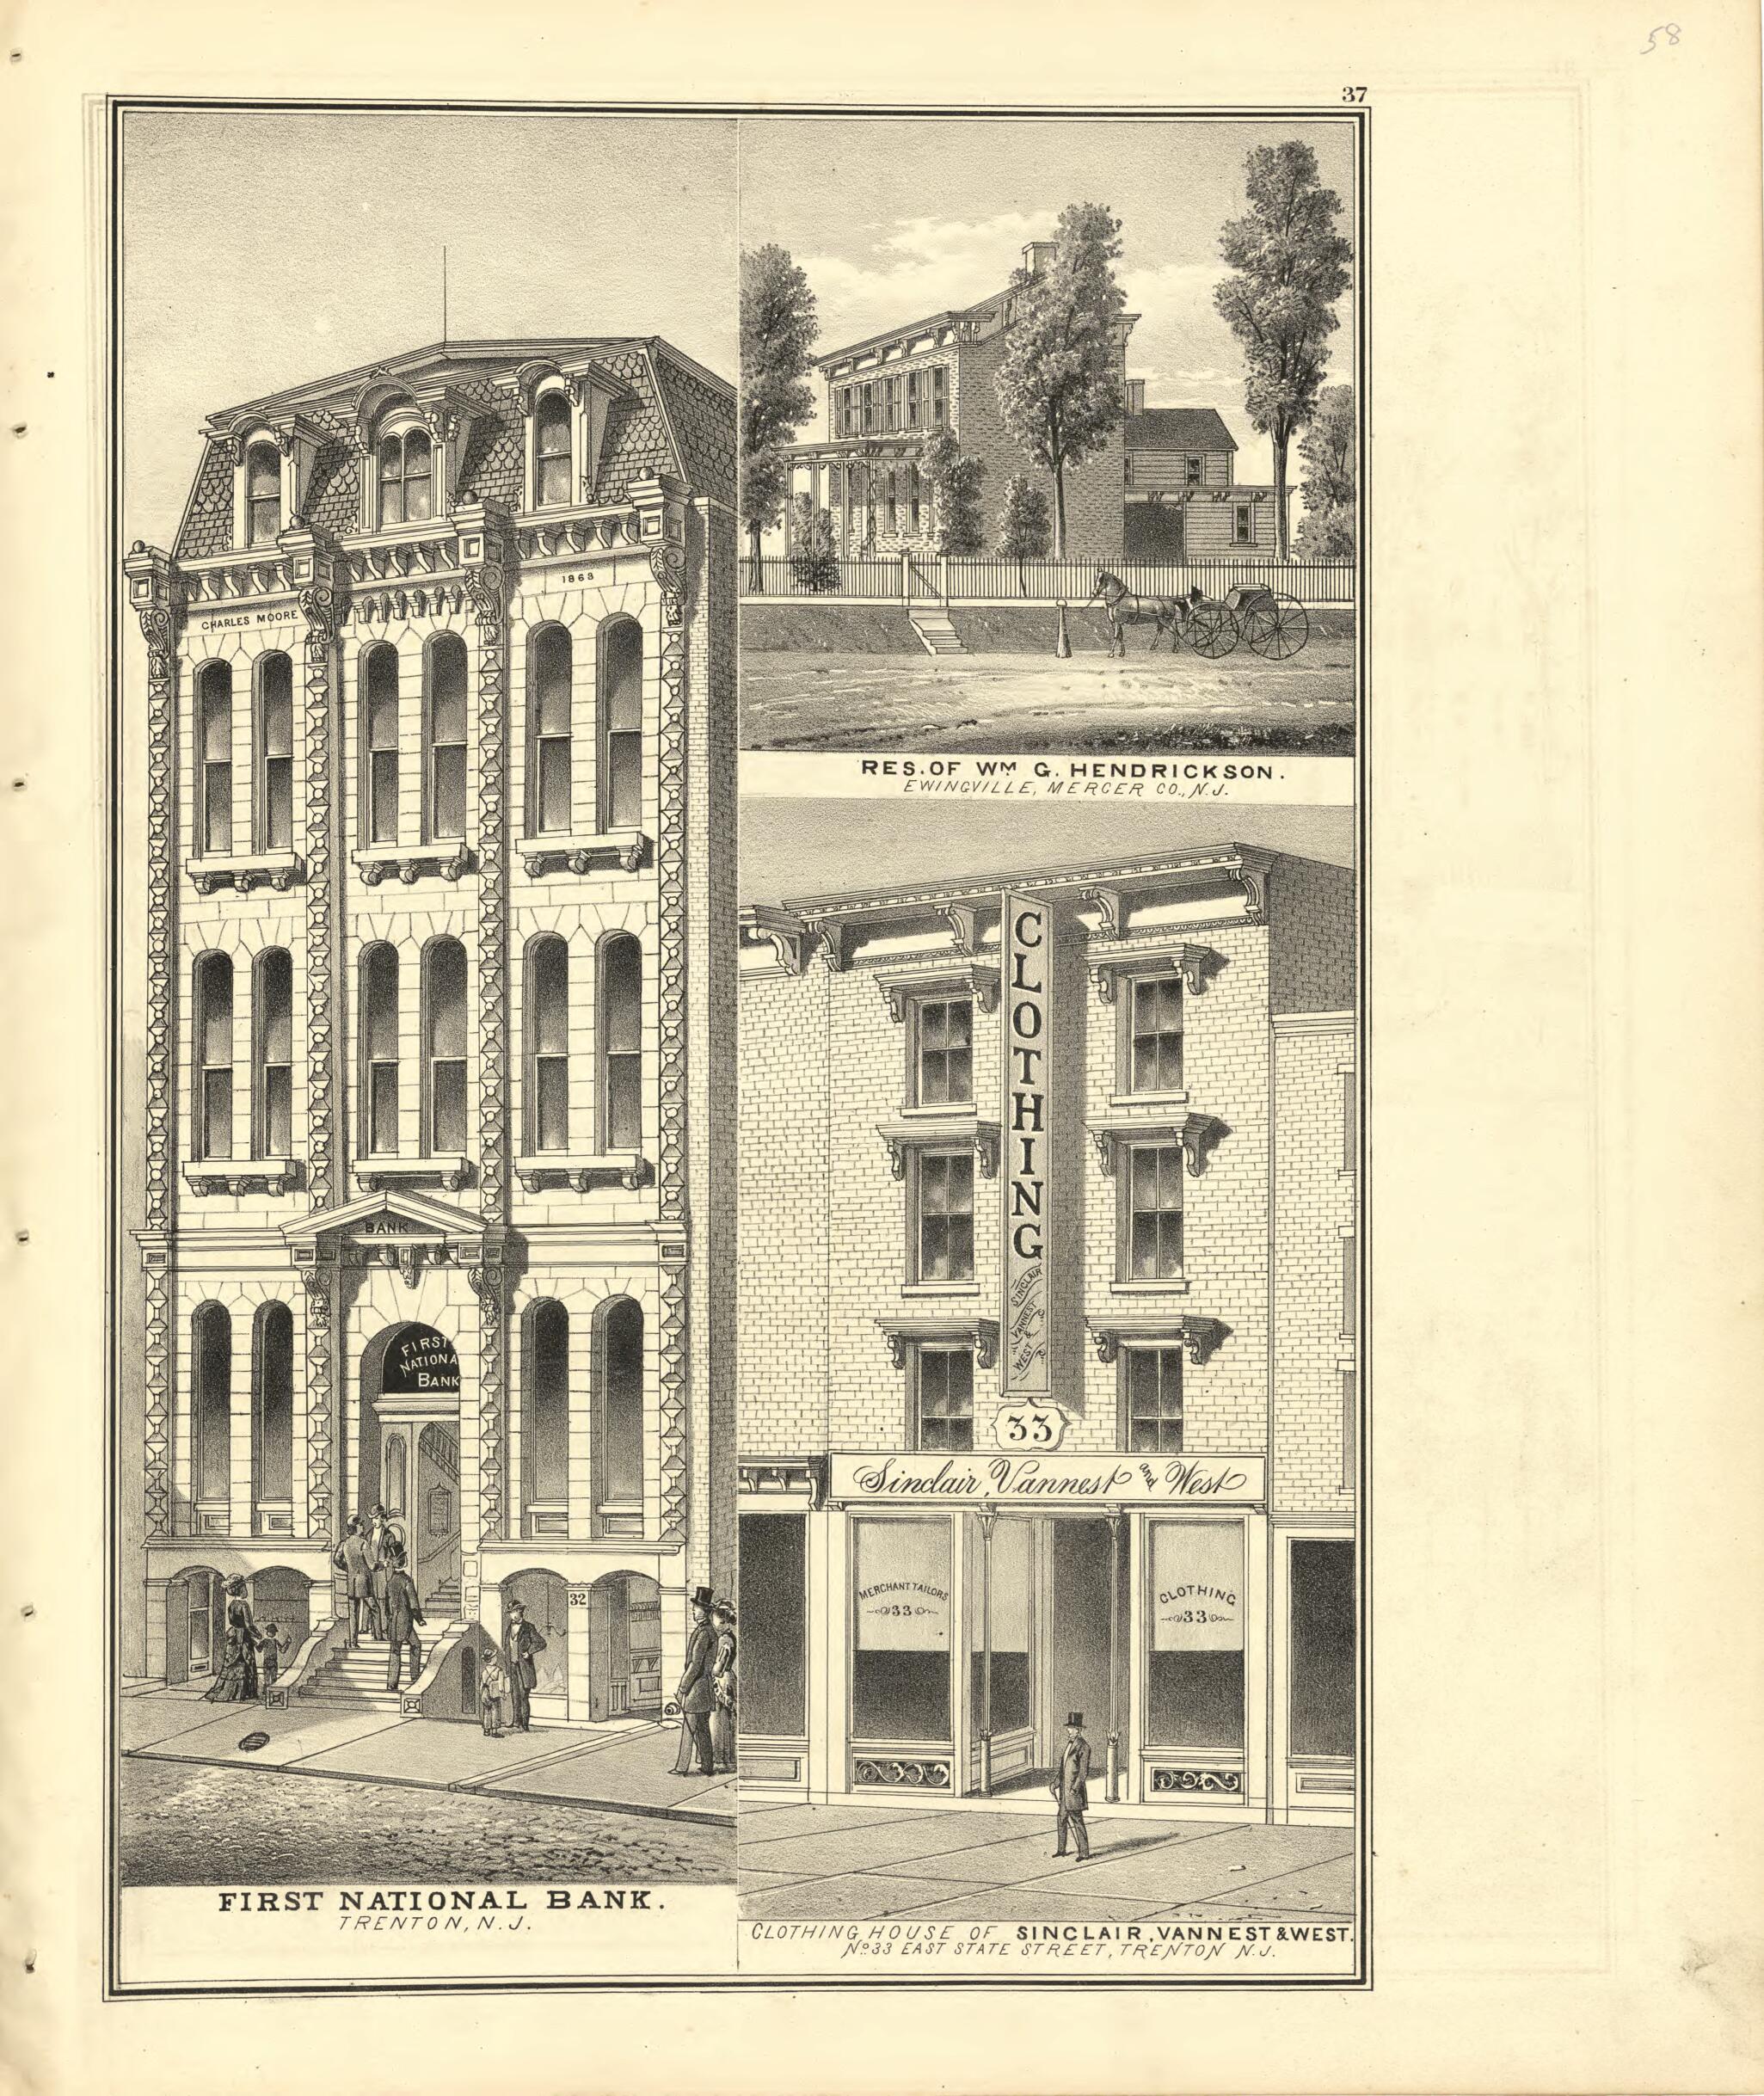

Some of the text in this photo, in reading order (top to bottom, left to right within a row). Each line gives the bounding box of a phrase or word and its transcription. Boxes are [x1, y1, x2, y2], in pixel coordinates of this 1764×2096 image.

[1640, 23, 1681, 55] 58
[1342, 87, 1368, 103] 37
[562, 572, 594, 584] 1863
[201, 610, 298, 630] CHARLES MOORE
[930, 761, 961, 776] OF
[1034, 762, 1060, 778] G.
[1070, 763, 1285, 779] HENDRICKSON.
[904, 779, 1037, 796] EWINGVILLE,
[1048, 781, 1145, 797] MERCER
[1188, 782, 1229, 799] N.J.
[1011, 911, 1044, 1260] CLOTHING
[366, 1222, 409, 1233] BANK
[1011, 1268, 1042, 1306] SINCLAIR
[1011, 1301, 1037, 1338] VANNEST
[1023, 1331, 1032, 1339] &
[402, 1336, 447, 1356] FIRST
[1012, 1343, 1033, 1371] WEST
[1007, 1413, 1052, 1442] 33
[988, 1457, 1132, 1495] Vannest
[1140, 1463, 1159, 1492] and
[1165, 1460, 1246, 1495] West
[569, 1593, 587, 1606] 32
[859, 1583, 949, 1601] MERCHANT TAILORS
[1159, 1585, 1236, 1607] CLOTHING
[892, 1605, 912, 1616] 33
[1183, 1610, 1207, 1623] 33
[218, 1890, 664, 1911] FIRST NATIONAL BANK.
[340, 1915, 532, 1933] TRENTON, N.J.
[752, 1922, 859, 1939] CLOTHING
[869, 1925, 955, 1939] HOUSE
[969, 1926, 999, 1939] OF
[901, 1942, 947, 1955] EAST
[954, 1943, 1011, 1956] STATE
[1021, 1944, 1113, 1958] STREET,
[1121, 1942, 1226, 1961] TRENTON
[1234, 1944, 1276, 1959] N.J.
